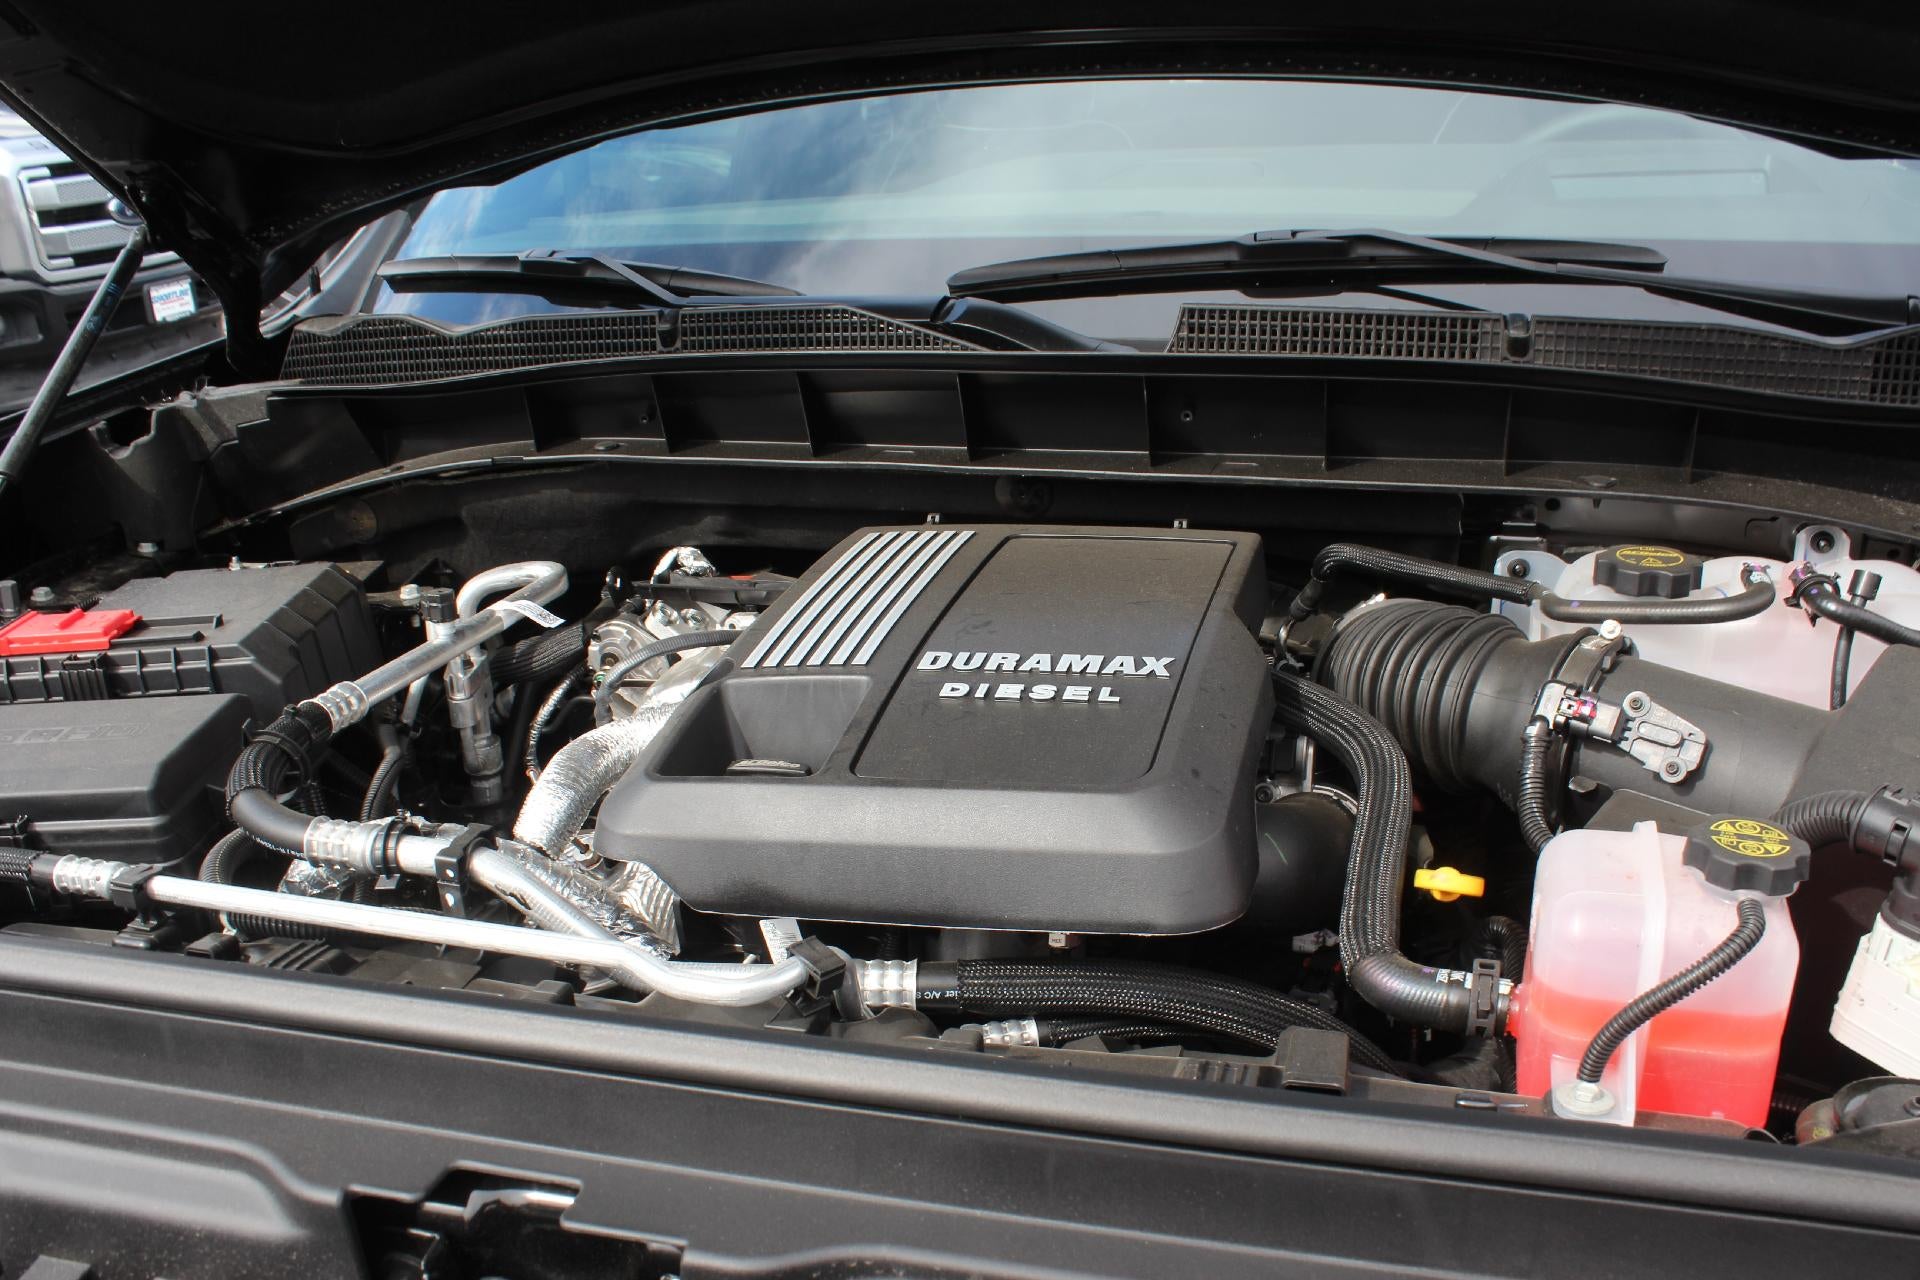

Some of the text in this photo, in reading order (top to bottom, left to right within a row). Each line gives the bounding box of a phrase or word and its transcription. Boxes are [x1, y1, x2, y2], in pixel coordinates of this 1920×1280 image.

[917, 651, 1176, 678] DURAMAX
[939, 683, 1121, 703] DIESEL
[924, 990, 941, 1000] A/C
[944, 990, 960, 1000] ier
